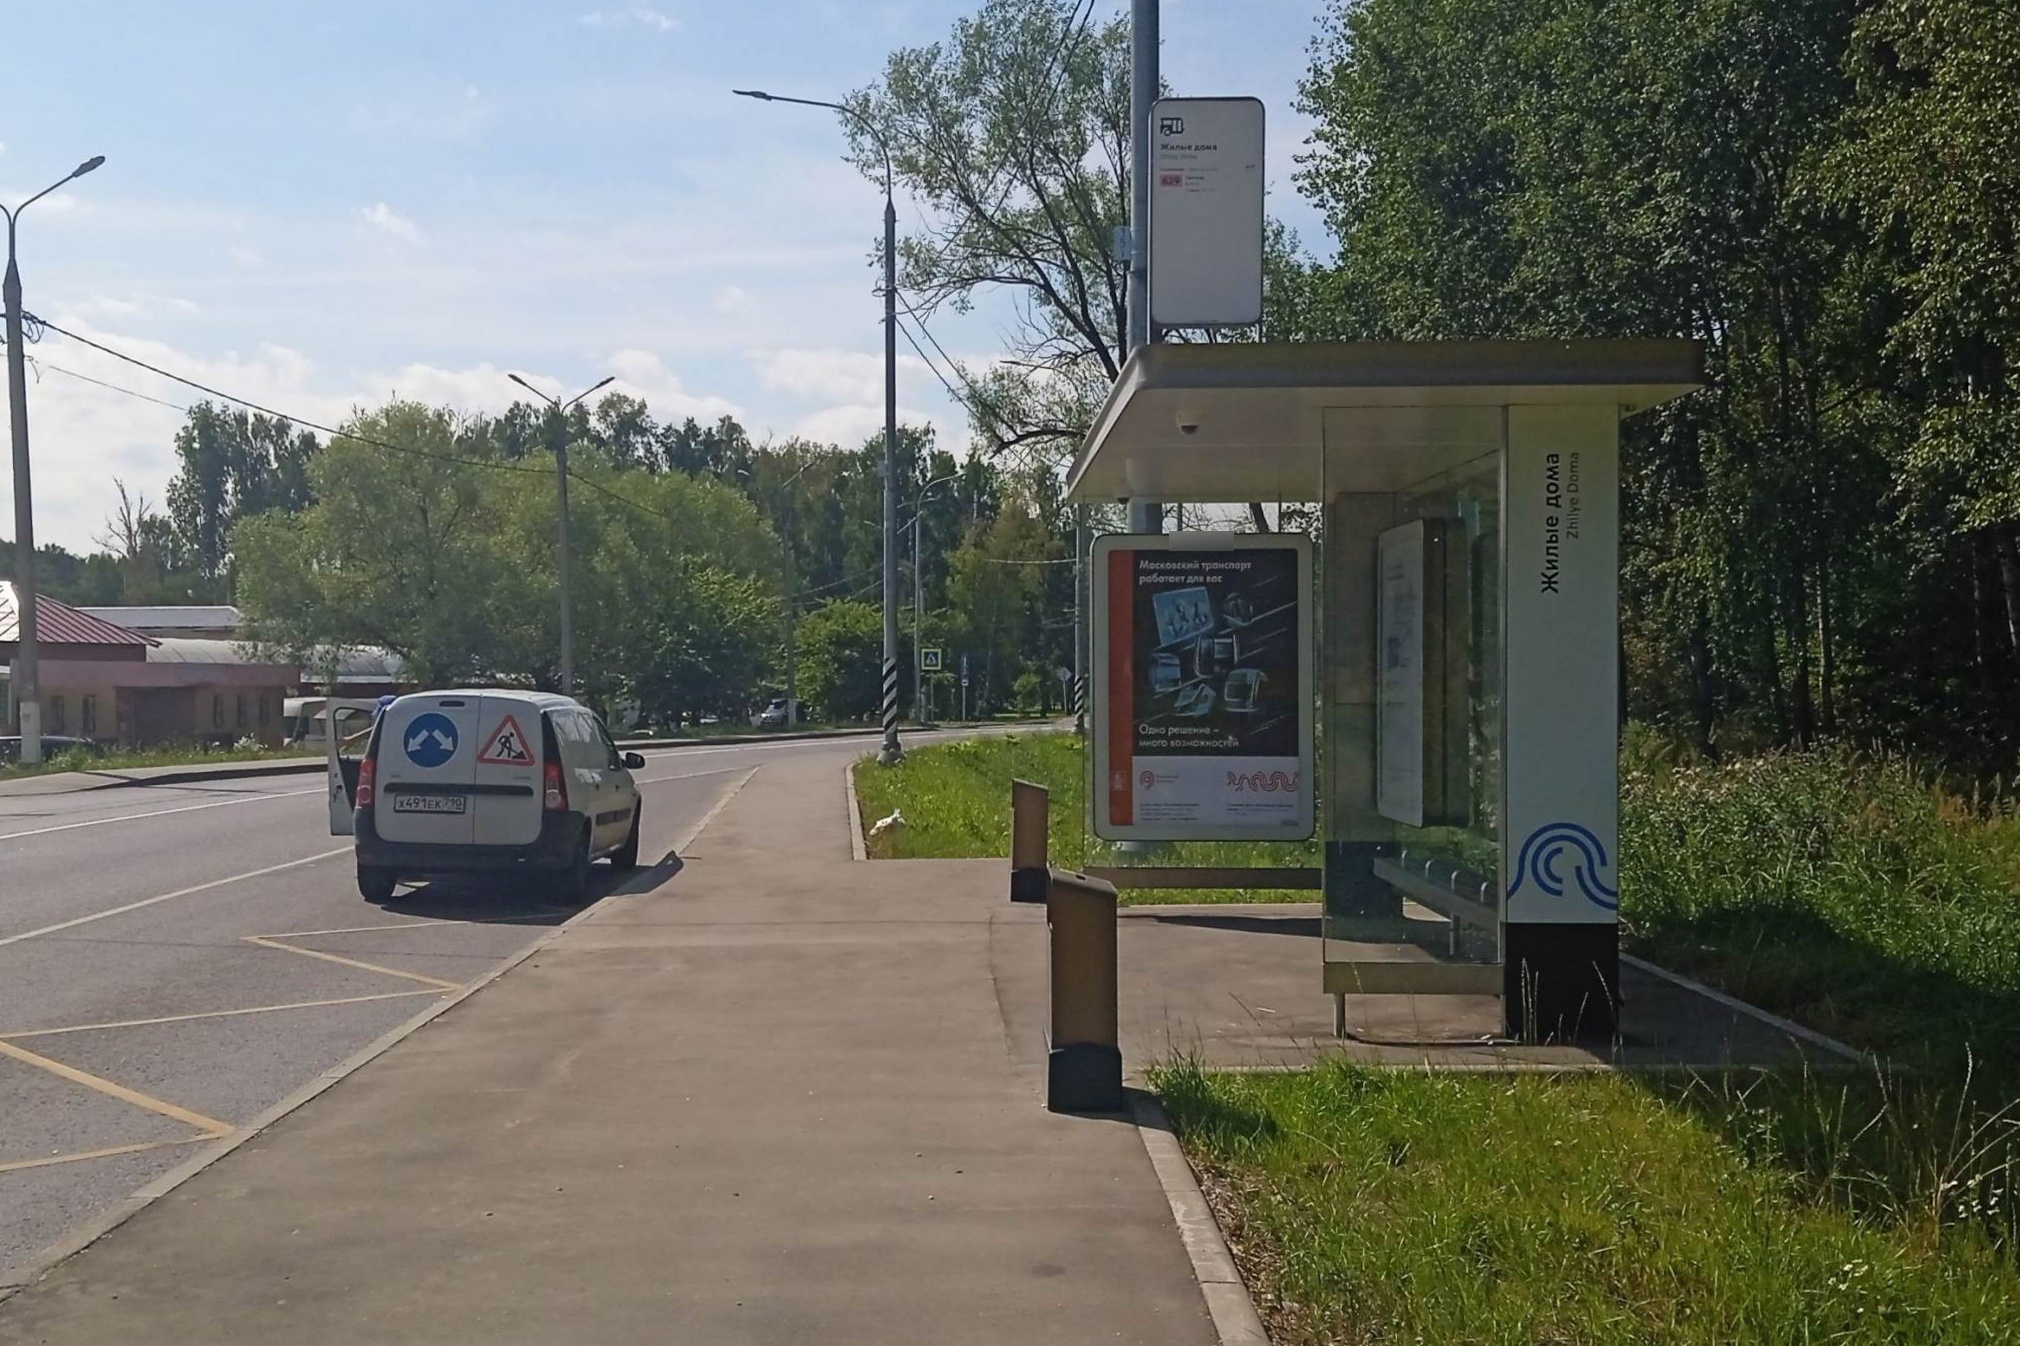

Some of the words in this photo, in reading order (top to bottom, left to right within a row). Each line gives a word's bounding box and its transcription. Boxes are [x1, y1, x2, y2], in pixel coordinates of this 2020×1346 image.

[1160, 143, 1193, 151] Жилые
[1566, 452, 1579, 494] Doma
[1546, 453, 1562, 511] дома
[1566, 498, 1582, 540] Zhilye
[1541, 516, 1560, 594] Жилые
[1139, 559, 1200, 570] Московский
[1201, 562, 1252, 572] транспорт
[1139, 574, 1186, 586] работает
[1186, 576, 1204, 584] для
[1206, 576, 1223, 584] вас
[1139, 723, 1167, 736] Одно
[1168, 726, 1211, 736] решение
[1139, 739, 1168, 748] много
[1170, 738, 1240, 748] возможностей
